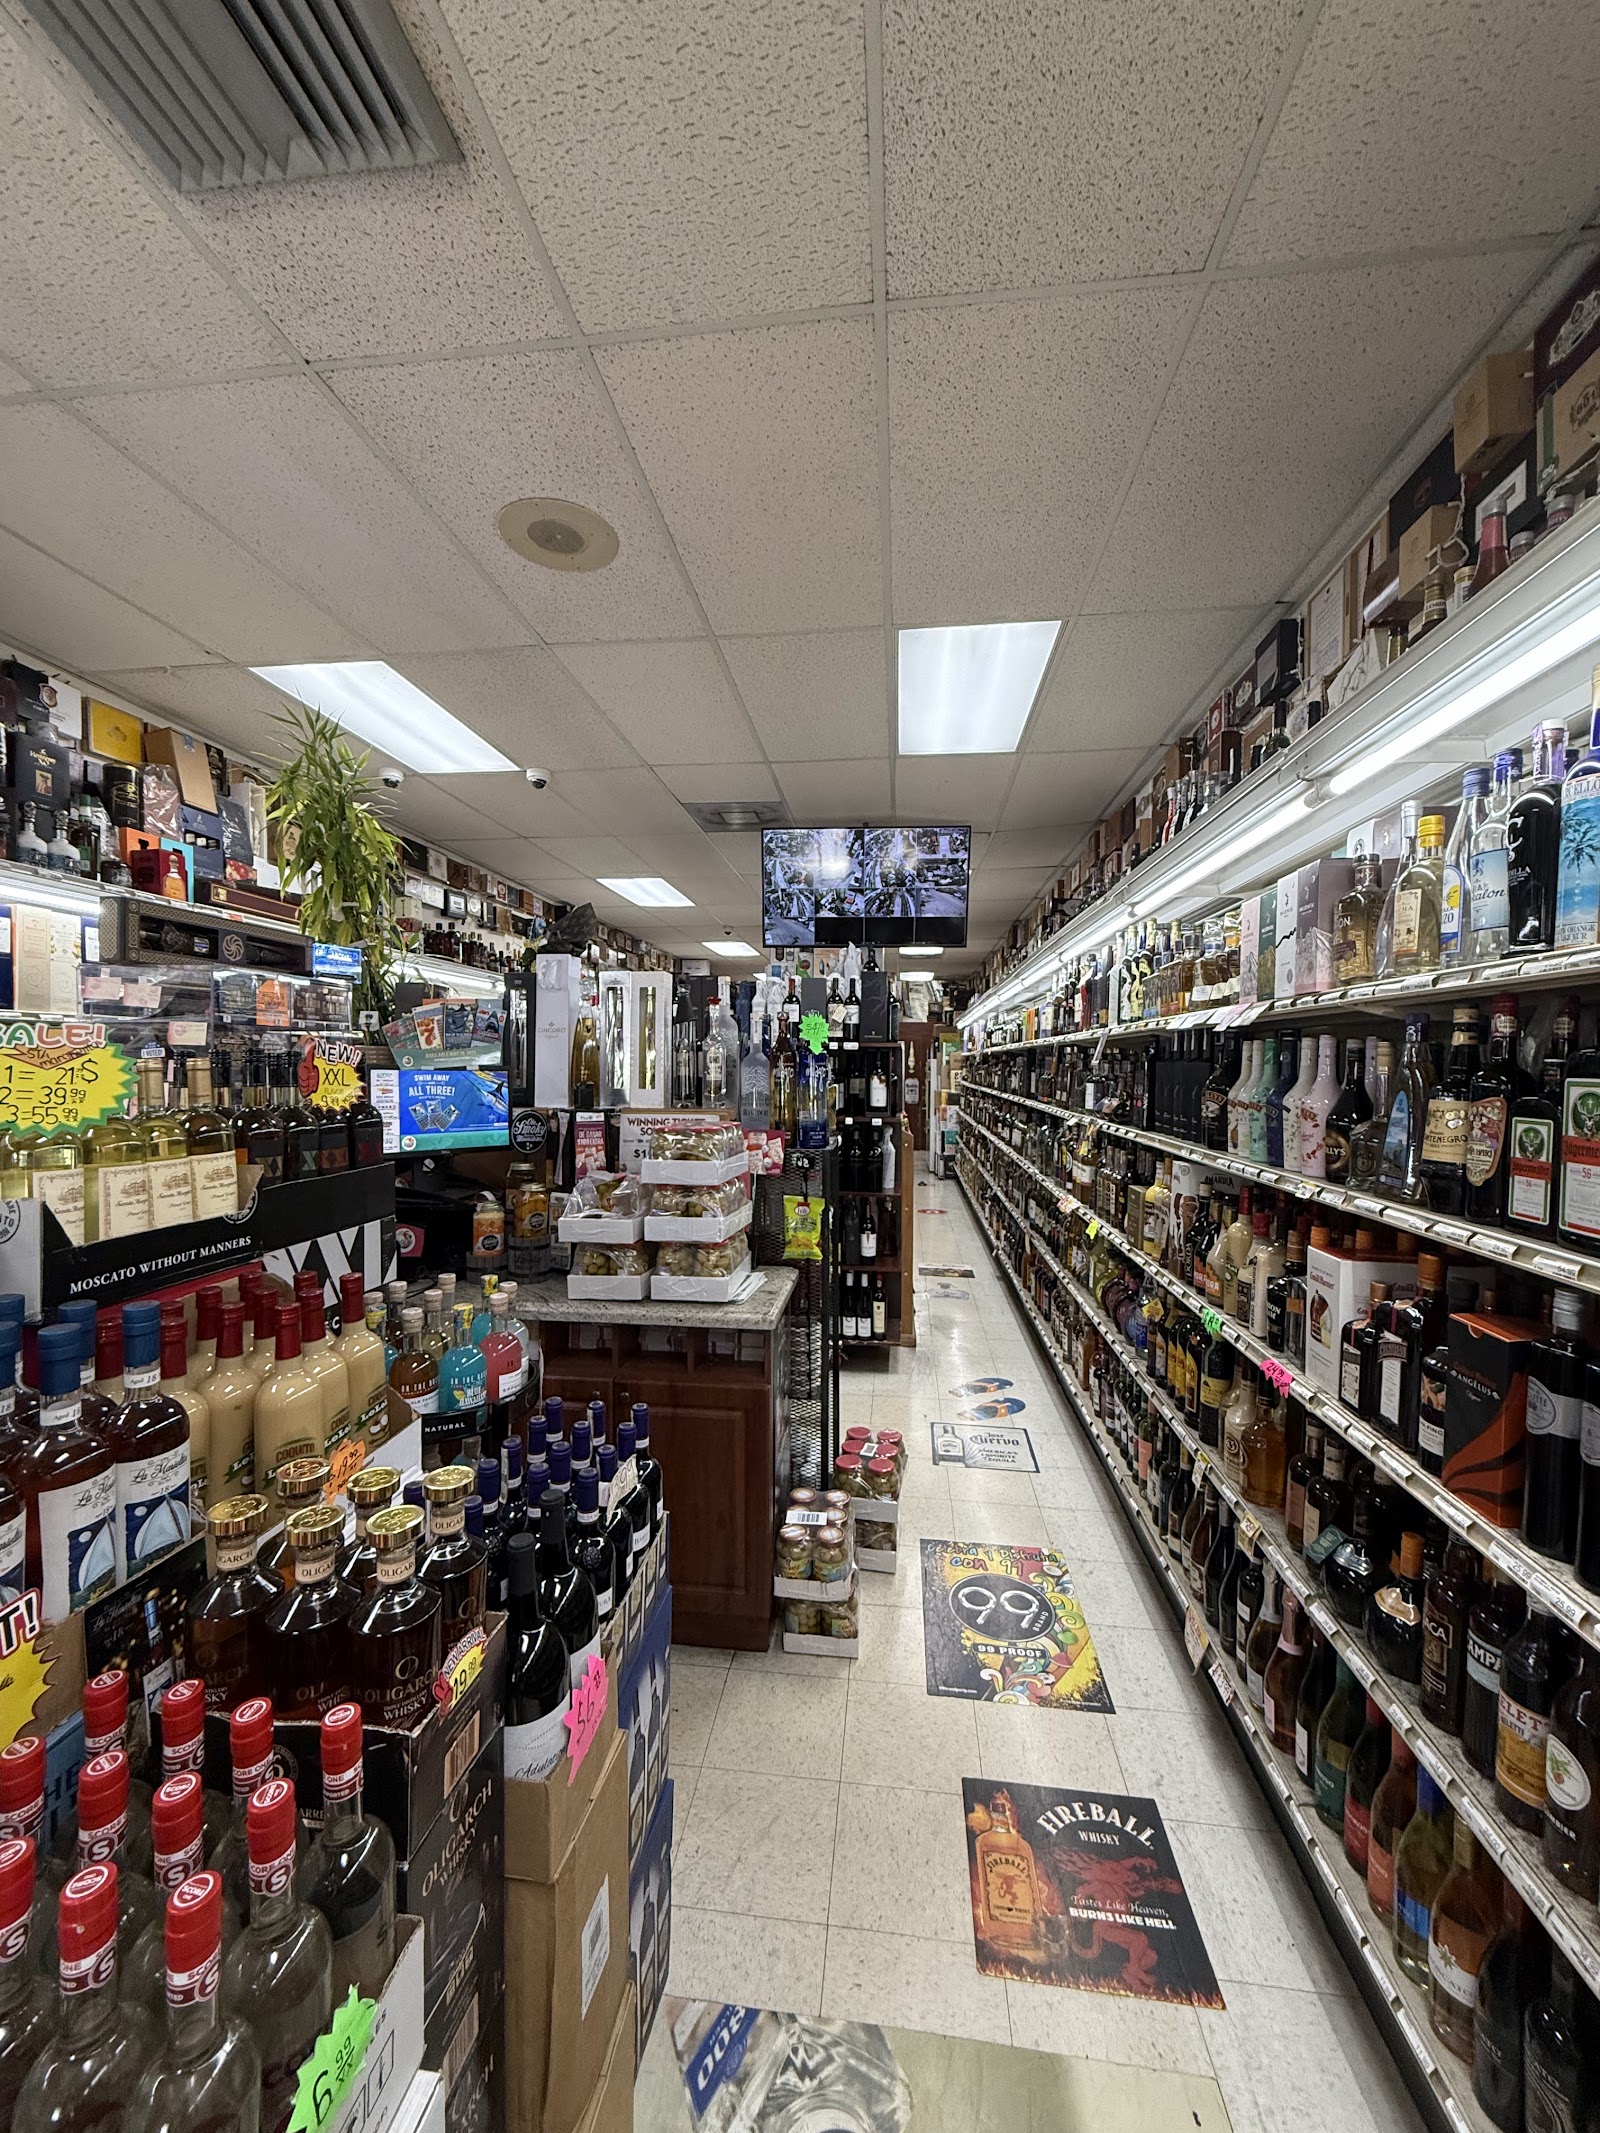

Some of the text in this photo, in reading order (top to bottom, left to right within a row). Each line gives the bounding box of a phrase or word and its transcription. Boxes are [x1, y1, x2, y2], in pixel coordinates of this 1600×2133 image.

[0, 1022, 107, 1049] ALE!
[315, 1038, 362, 1067] NEW!
[322, 1068, 351, 1087] XXL
[414, 1074, 451, 1082] SWIM AWAY
[408, 1085, 456, 1097] ALL THREE!
[627, 1117, 670, 1127] WINNING
[69, 1235, 252, 1295] MOSCATO WITHOUT MANNERS
[147, 1370, 157, 1383] 18
[424, 1422, 466, 1433] NATURAL
[969, 1434, 1020, 1446] Cuervo
[950, 1556, 1024, 1576] con 99
[957, 1586, 1040, 1629] 99
[1032, 1610, 1049, 1632] BRAND
[443, 1628, 487, 1679] NEW ARRIVAL
[977, 1644, 1043, 1659] 99 PROOF
[383, 1695, 429, 1720] WHISKY
[326, 1775, 345, 1784] ONE
[1036, 1801, 1157, 1850] FIREBALL
[421, 1778, 493, 1898] OLIGARCH
[1078, 1829, 1121, 1847] WHISKY
[986, 1857, 1031, 1880] FIREBALL
[1070, 1895, 1169, 1918] Tastes Like Heaven,
[1068, 1907, 1177, 1931] BURNS LIKE HELL
